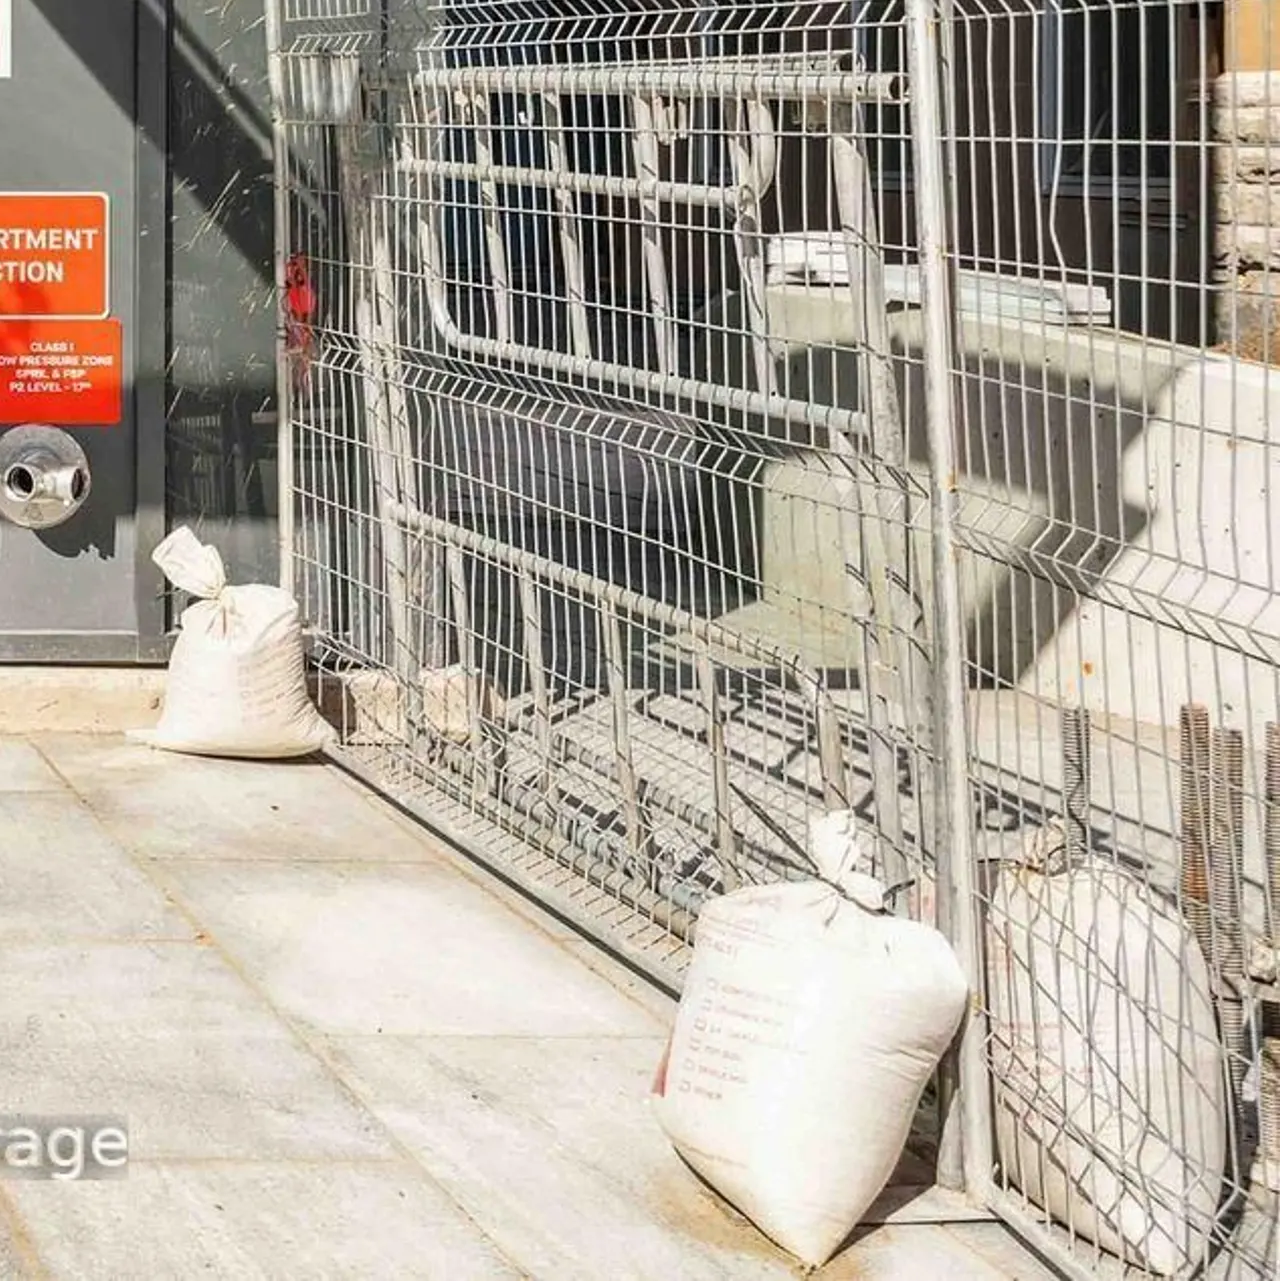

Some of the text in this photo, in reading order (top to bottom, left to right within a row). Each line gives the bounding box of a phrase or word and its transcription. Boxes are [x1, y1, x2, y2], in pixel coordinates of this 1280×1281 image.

[30, 341, 68, 352] CLASS
[19, 355, 79, 366] PRESSURE
[81, 355, 114, 366] ZONE
[27, 381, 62, 392] LEVEL
